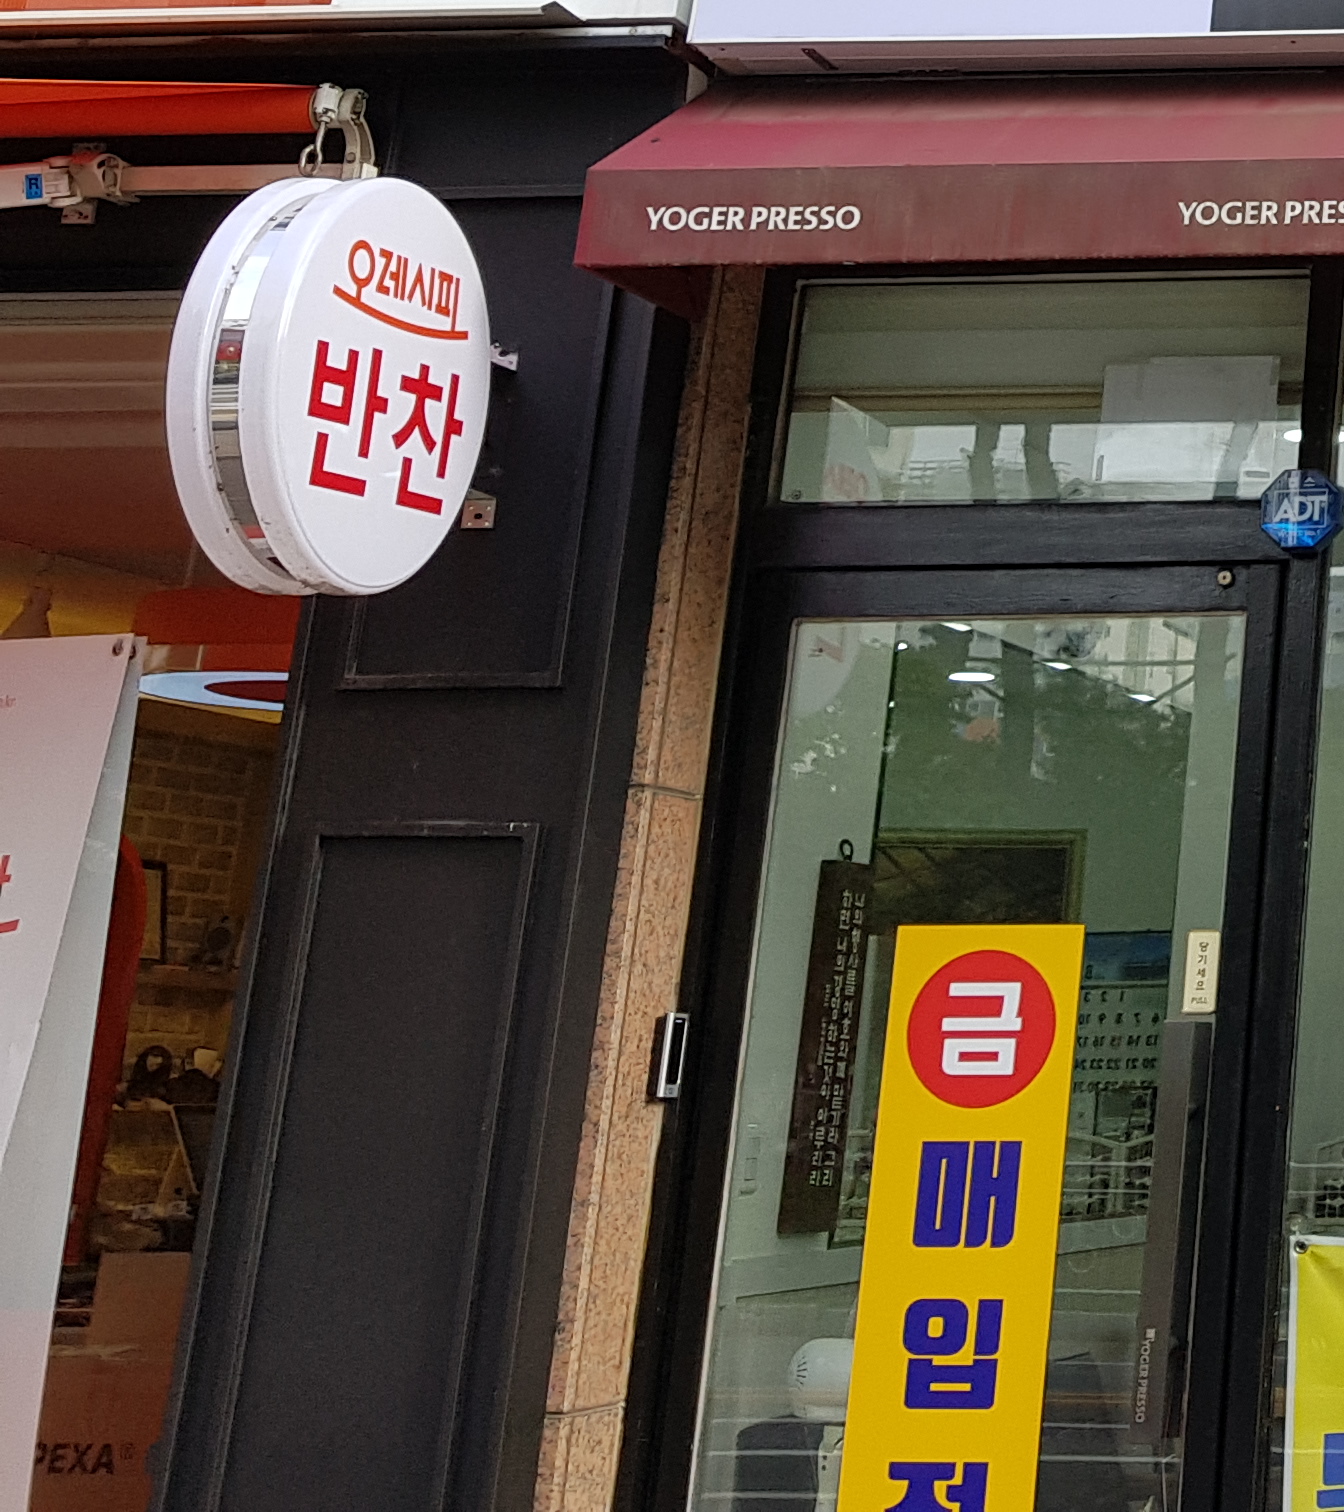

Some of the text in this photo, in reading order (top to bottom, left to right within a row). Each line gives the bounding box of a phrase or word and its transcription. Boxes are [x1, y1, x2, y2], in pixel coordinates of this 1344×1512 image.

[645, 205, 861, 232] YOGER PRESSO
[1178, 200, 1279, 226] YOGER
[334, 239, 468, 339] 오레시피
[307, 340, 463, 516] 반찬
[1272, 495, 1327, 523] ADT
[941, 981, 1023, 1076] 금
